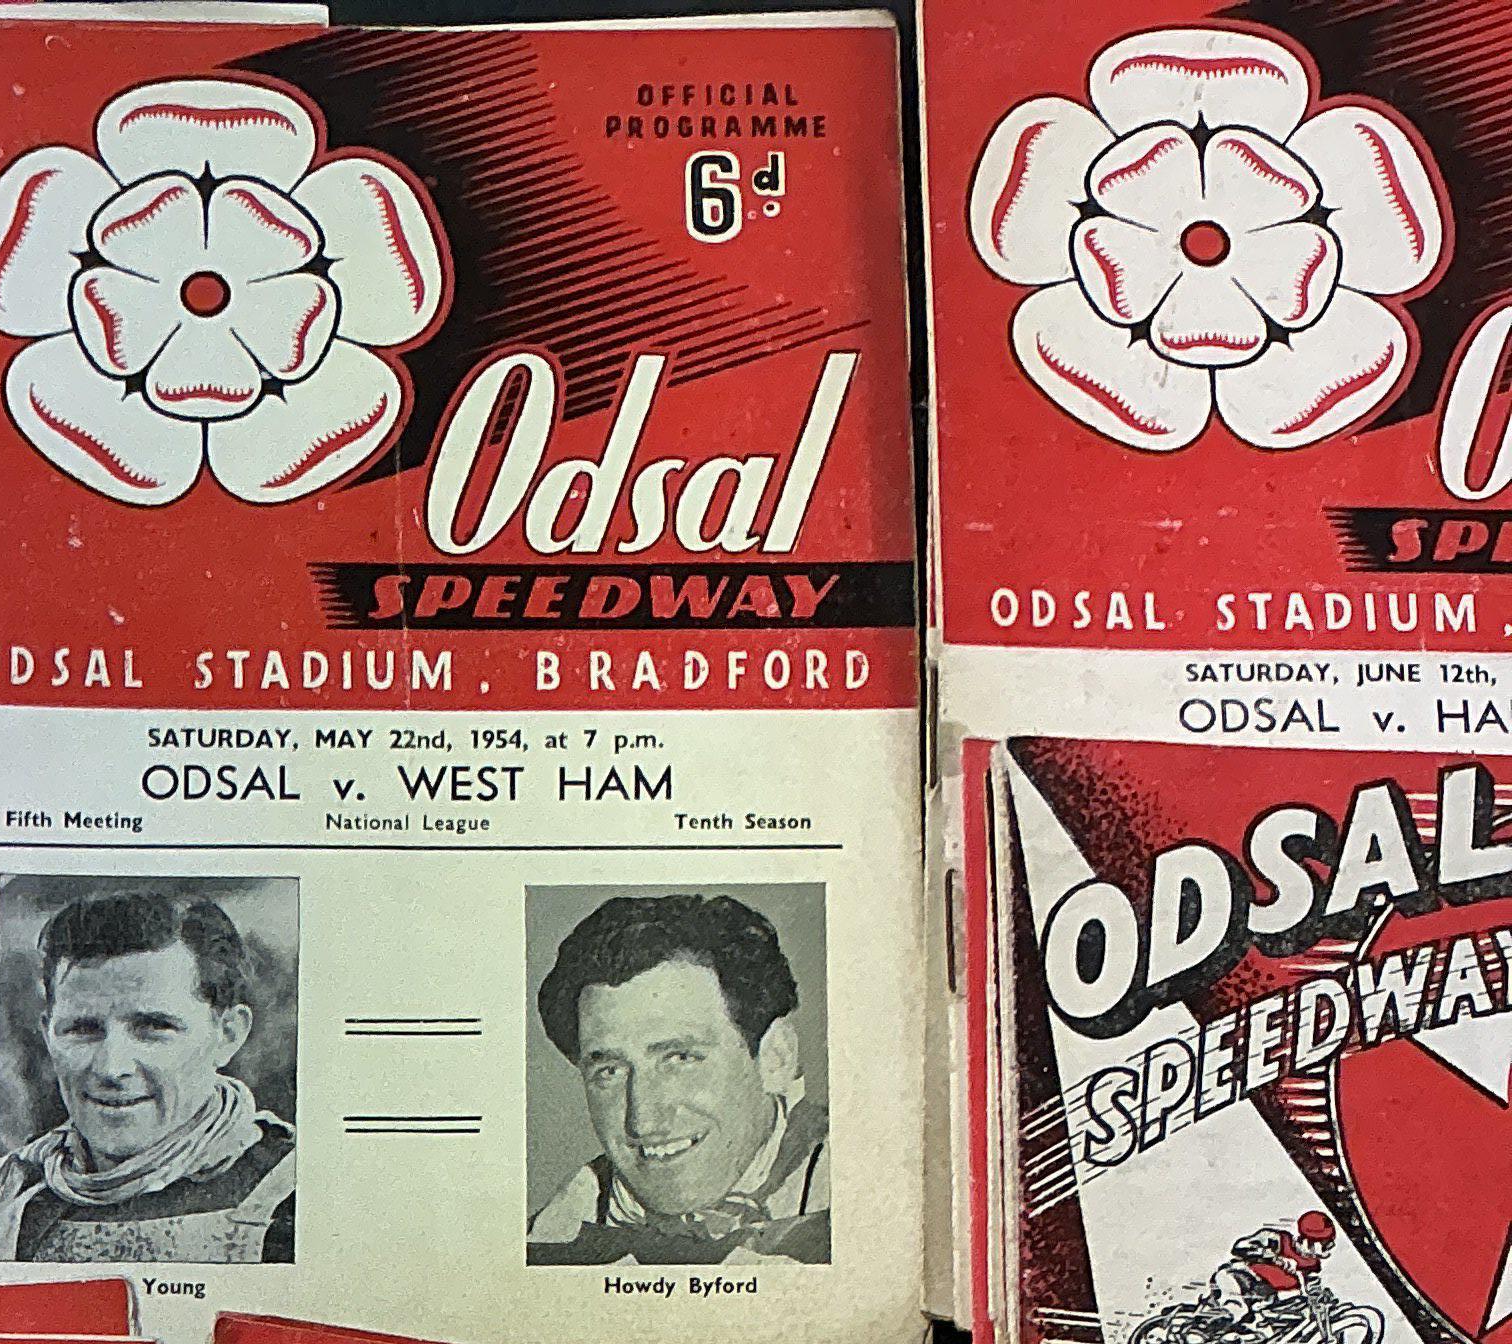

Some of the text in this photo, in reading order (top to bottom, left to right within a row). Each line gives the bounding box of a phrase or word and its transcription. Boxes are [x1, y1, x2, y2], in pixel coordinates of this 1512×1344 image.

[637, 83, 799, 107] OFFICIAL
[604, 115, 827, 139] PROGRAMME
[426, 351, 861, 556] Odsal
[369, 575, 840, 620] SPEEDWAY
[990, 588, 1167, 631] ODSAL
[536, 648, 871, 691] BRADFORD
[1187, 663, 1498, 686] SATURDAY, JUNE 12th,
[1179, 698, 1341, 734] ODSAL
[147, 729, 665, 754] SATURDAY, MAY 22nd, 1954, p.m.
[141, 765, 673, 801] ODSAL WEST HAM
[6, 810, 144, 833] Fifth Meeting
[326, 813, 490, 833] National League
[675, 813, 812, 831] Tenth Season
[1044, 766, 1512, 1032] ODSAL
[142, 1278, 206, 1299] Young
[604, 1276, 758, 1298] Howdy Byford
